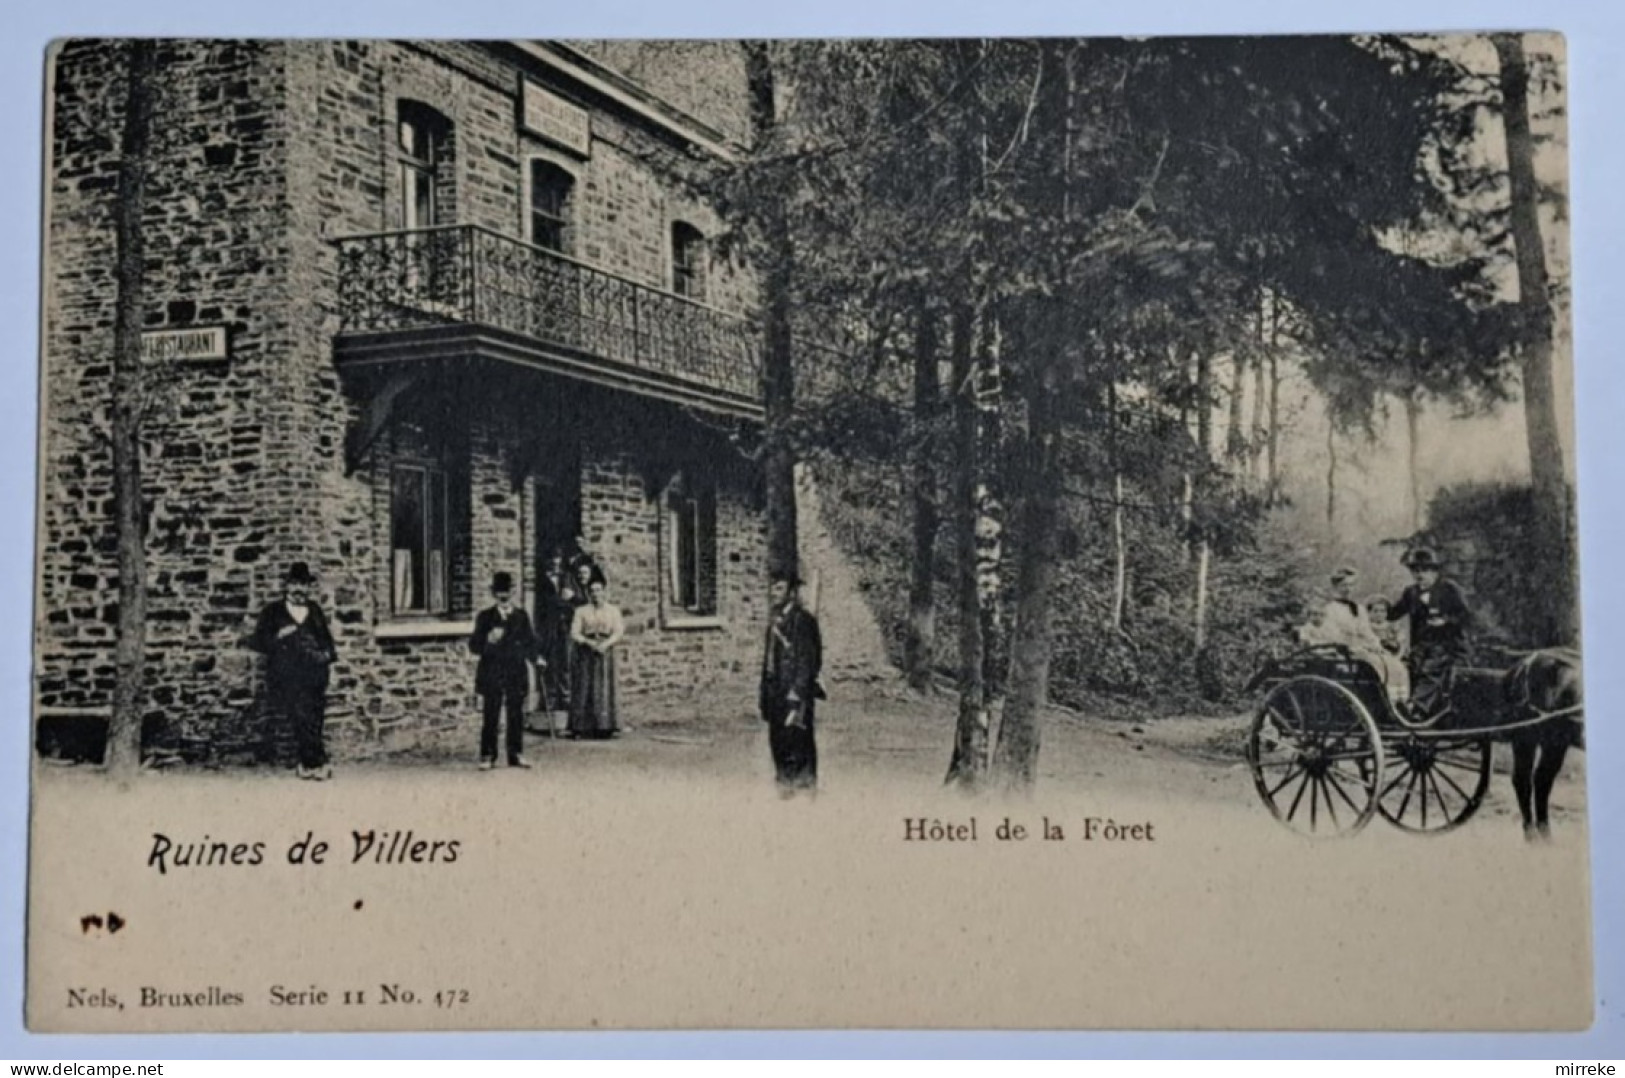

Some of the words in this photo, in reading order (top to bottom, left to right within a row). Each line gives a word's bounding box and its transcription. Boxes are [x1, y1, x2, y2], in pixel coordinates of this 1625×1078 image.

[903, 816, 977, 842] Hôtel
[995, 817, 1027, 842] de
[1042, 816, 1065, 842] la
[1083, 817, 1156, 842] Fôret
[147, 832, 266, 875] Ruines
[286, 830, 330, 865] de
[350, 829, 462, 866] Villers
[67, 987, 125, 1011] Nels,
[140, 986, 244, 1007] Bruxelles
[269, 985, 329, 1006] Serie
[379, 983, 422, 1005] No.
